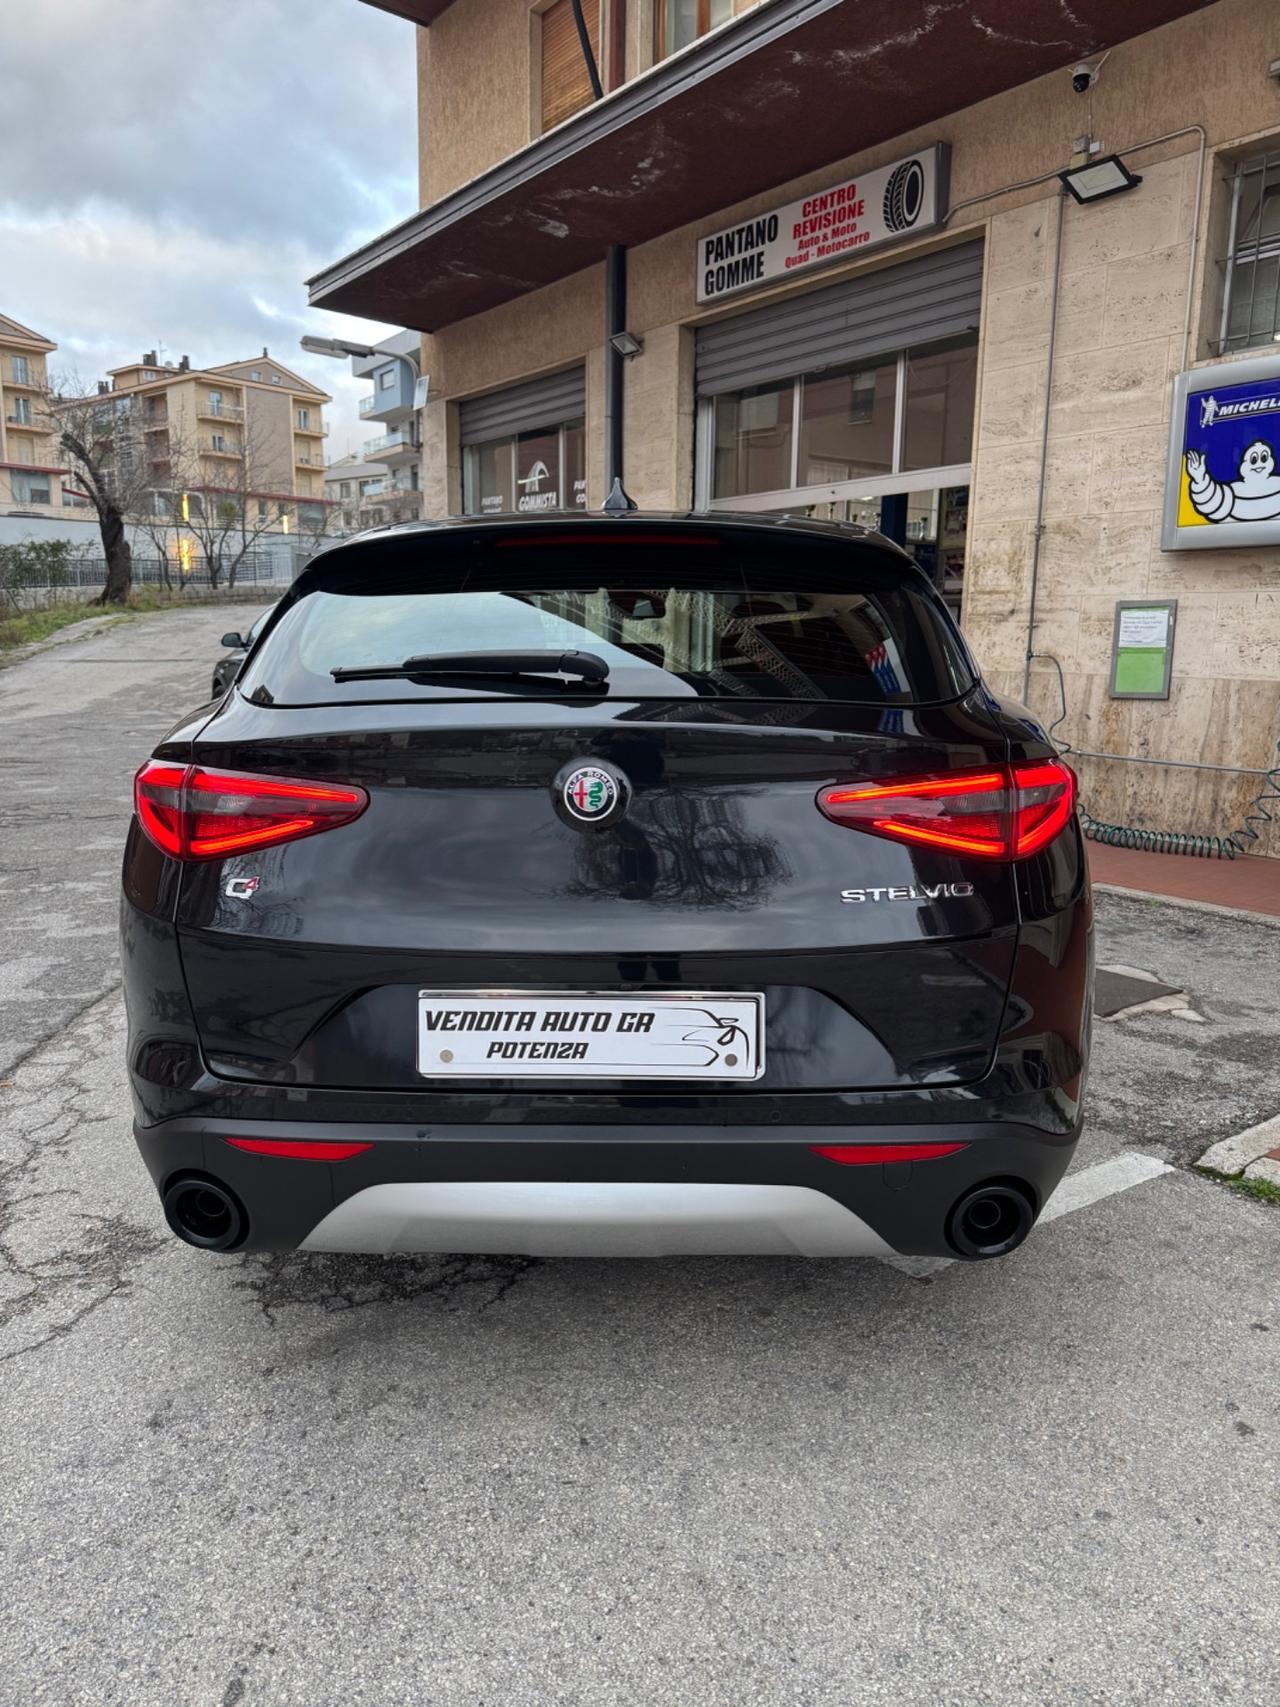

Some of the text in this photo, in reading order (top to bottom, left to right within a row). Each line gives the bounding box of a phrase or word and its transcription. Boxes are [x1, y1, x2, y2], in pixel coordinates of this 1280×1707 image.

[802, 184, 856, 218] CENTRO
[793, 199, 865, 240] REVISIONE
[705, 214, 779, 266] PANTANO
[785, 251, 810, 269] Quad
[816, 232, 870, 257] Motocarro
[798, 223, 857, 251] Auto & Moto
[705, 251, 765, 296] GOMME
[840, 882, 975, 903] STELVIO
[425, 1010, 656, 1033] VENDITA AUTO GR
[486, 1041, 589, 1059] POTENZA
